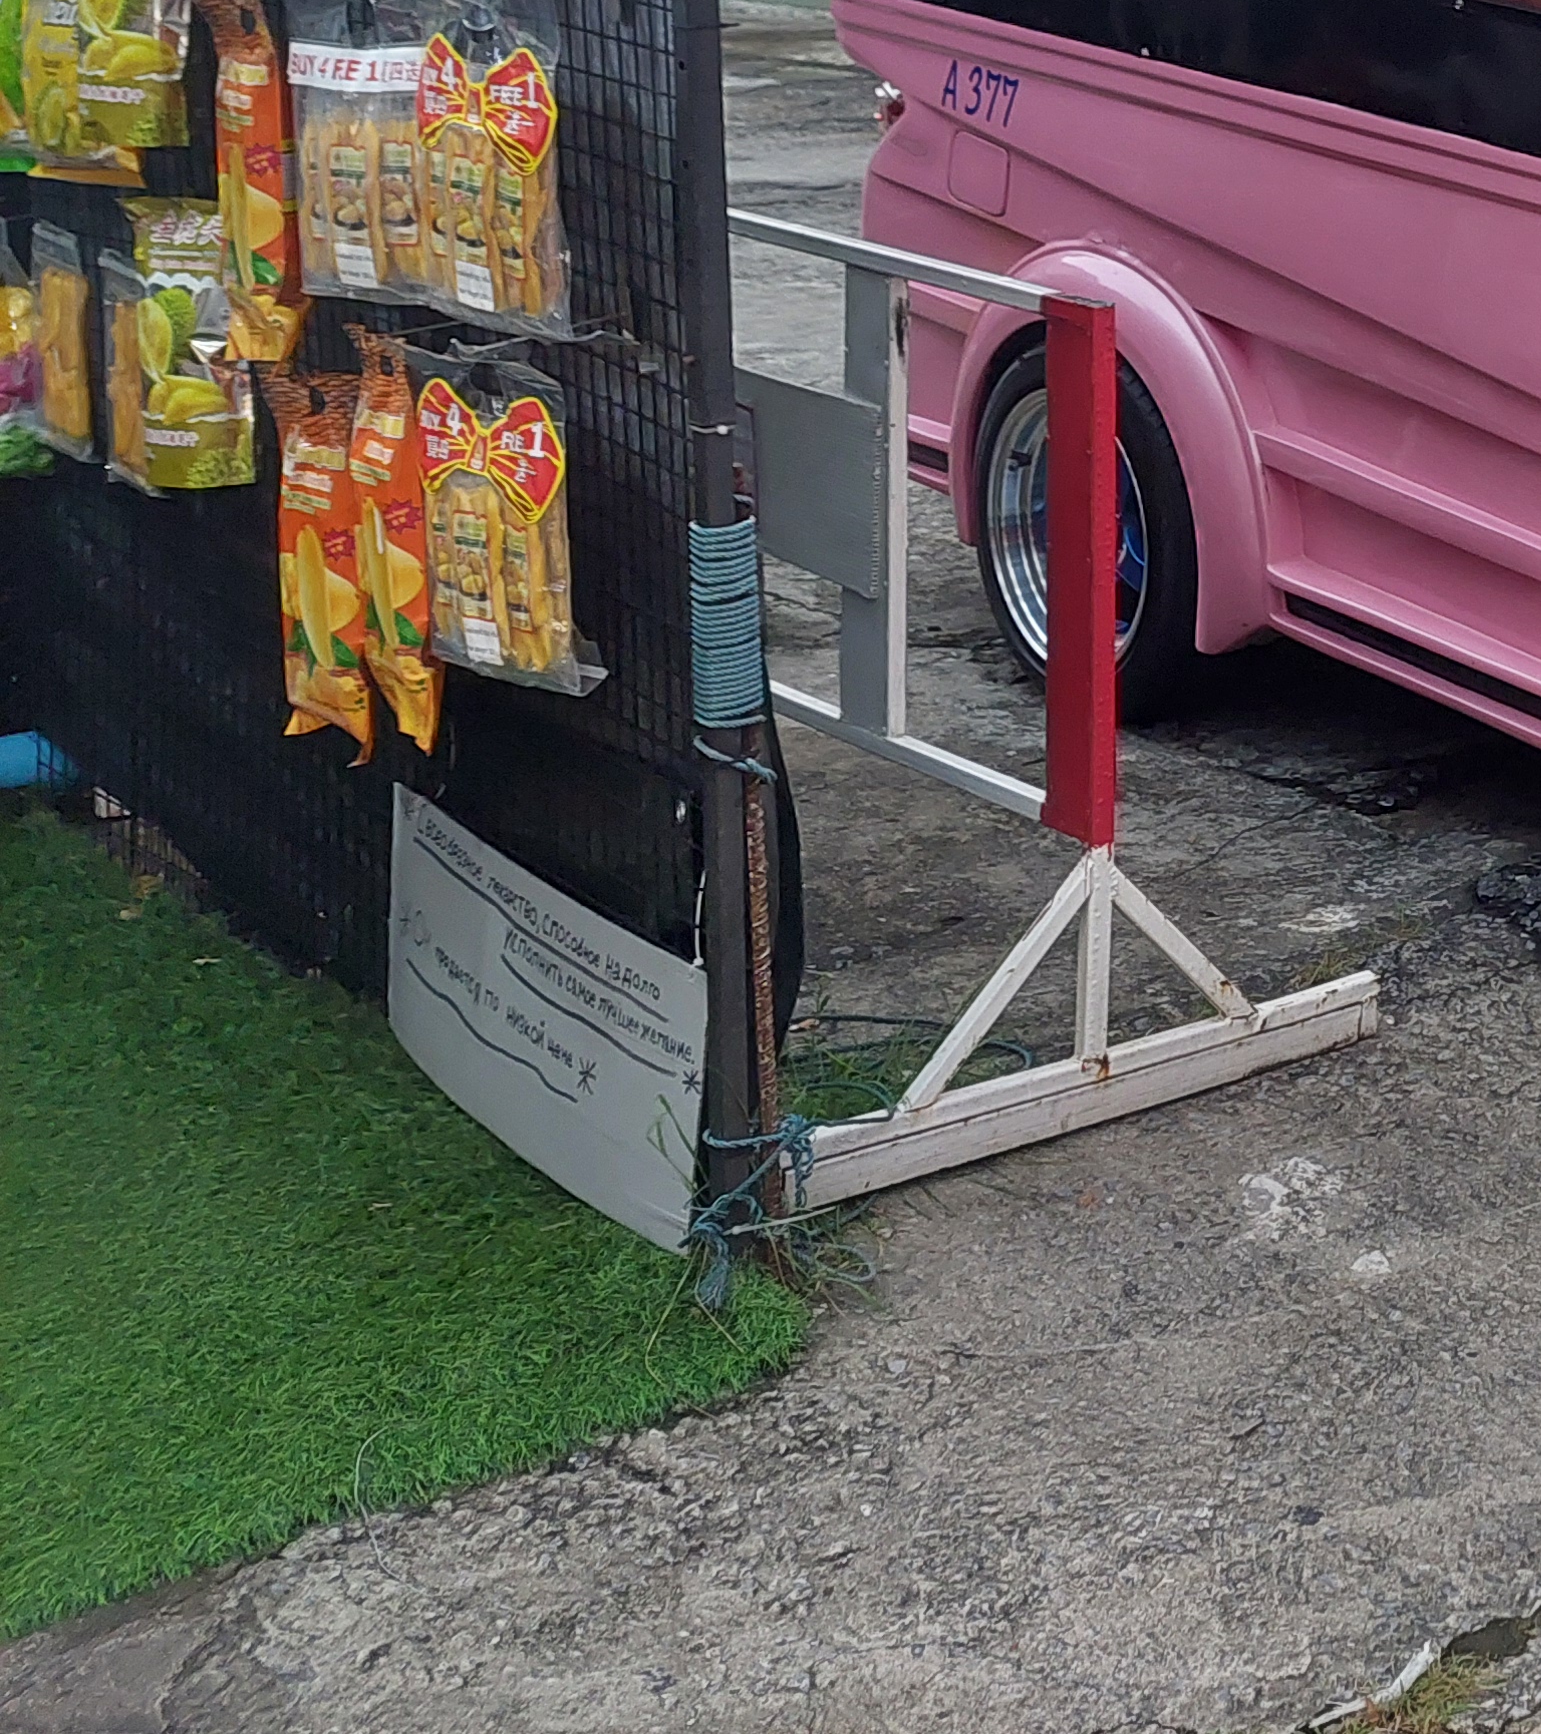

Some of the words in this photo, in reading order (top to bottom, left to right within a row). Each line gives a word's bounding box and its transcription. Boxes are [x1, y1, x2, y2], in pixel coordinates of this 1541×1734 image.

[941, 58, 958, 112] A
[964, 65, 1020, 128] 377
[529, 421, 545, 459] 1
